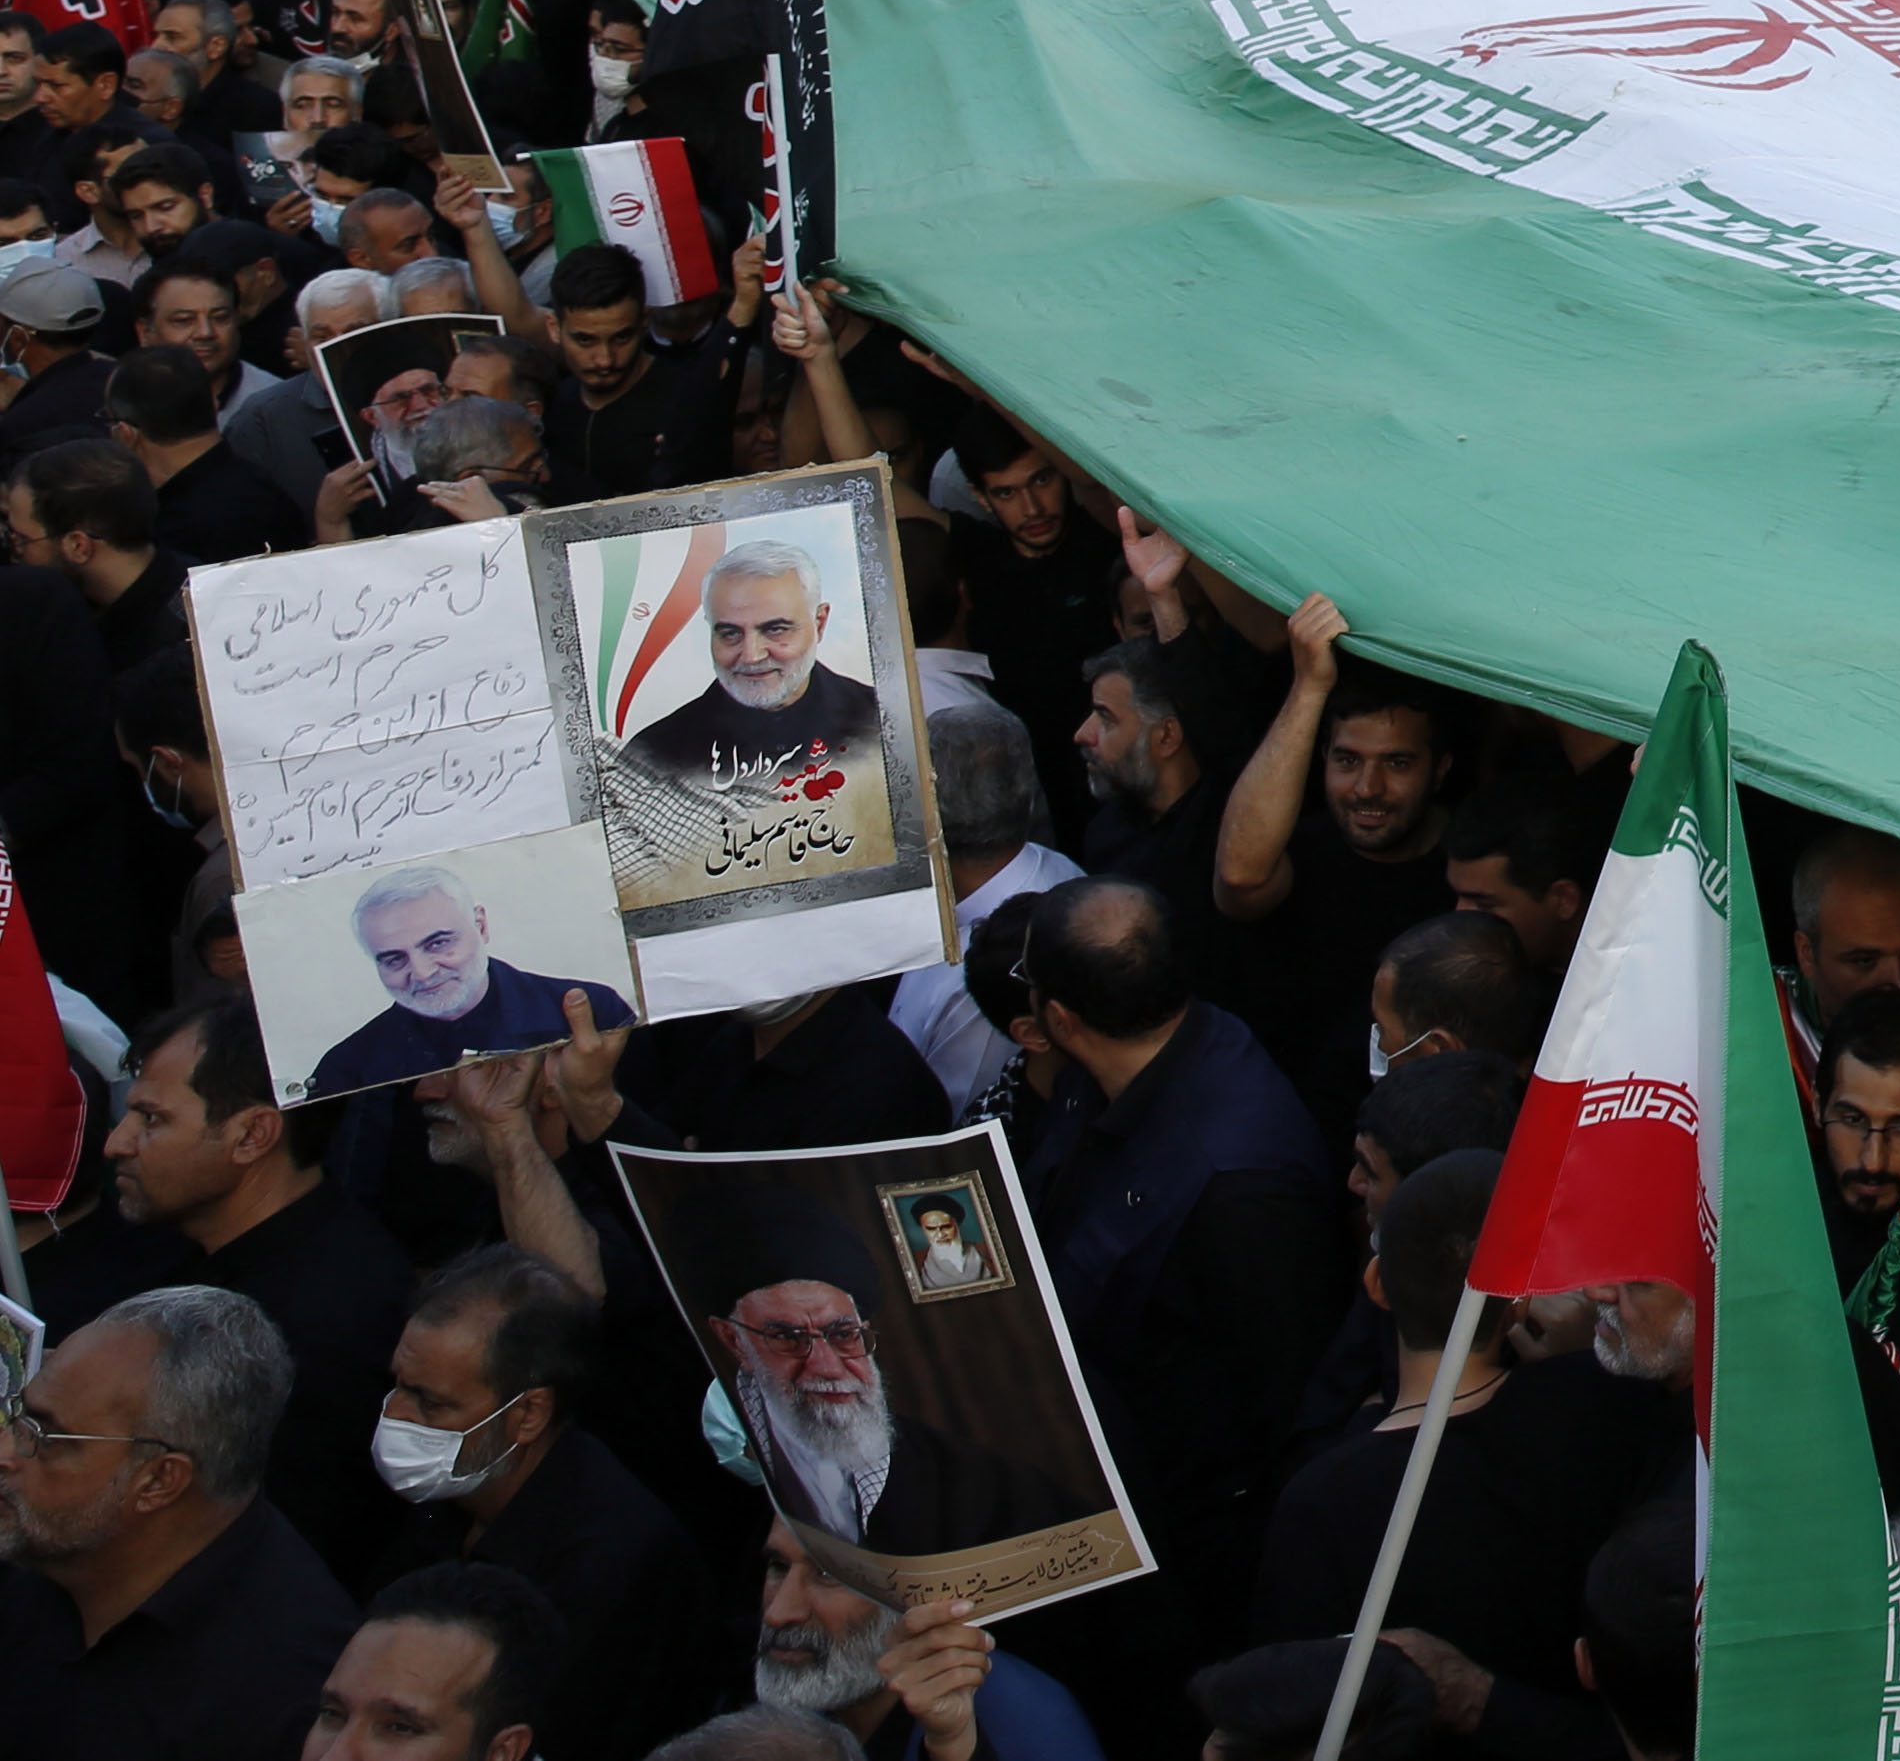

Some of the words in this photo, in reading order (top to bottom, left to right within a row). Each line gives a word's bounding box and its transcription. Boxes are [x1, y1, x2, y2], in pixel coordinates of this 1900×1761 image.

[447, 525, 520, 617] کل
[224, 589, 323, 662] اسلامی
[332, 564, 453, 642] جمهوری
[233, 653, 344, 696] است
[353, 635, 450, 709] حرم
[465, 662, 526, 734] دفاع
[357, 693, 417, 756] این
[414, 687, 447, 745] از
[412, 748, 476, 816] دفاع
[473, 750, 505, 798] از
[480, 719, 556, 812] کمتر
[713, 744, 749, 791] دل
[747, 742, 803, 780] سردار
[771, 738, 832, 803] شهید
[351, 771, 419, 839] حرم
[380, 792, 411, 839] از
[806, 808, 856, 856] حاج
[705, 816, 777, 877] سلیمانی
[764, 812, 810, 871] قاسم
